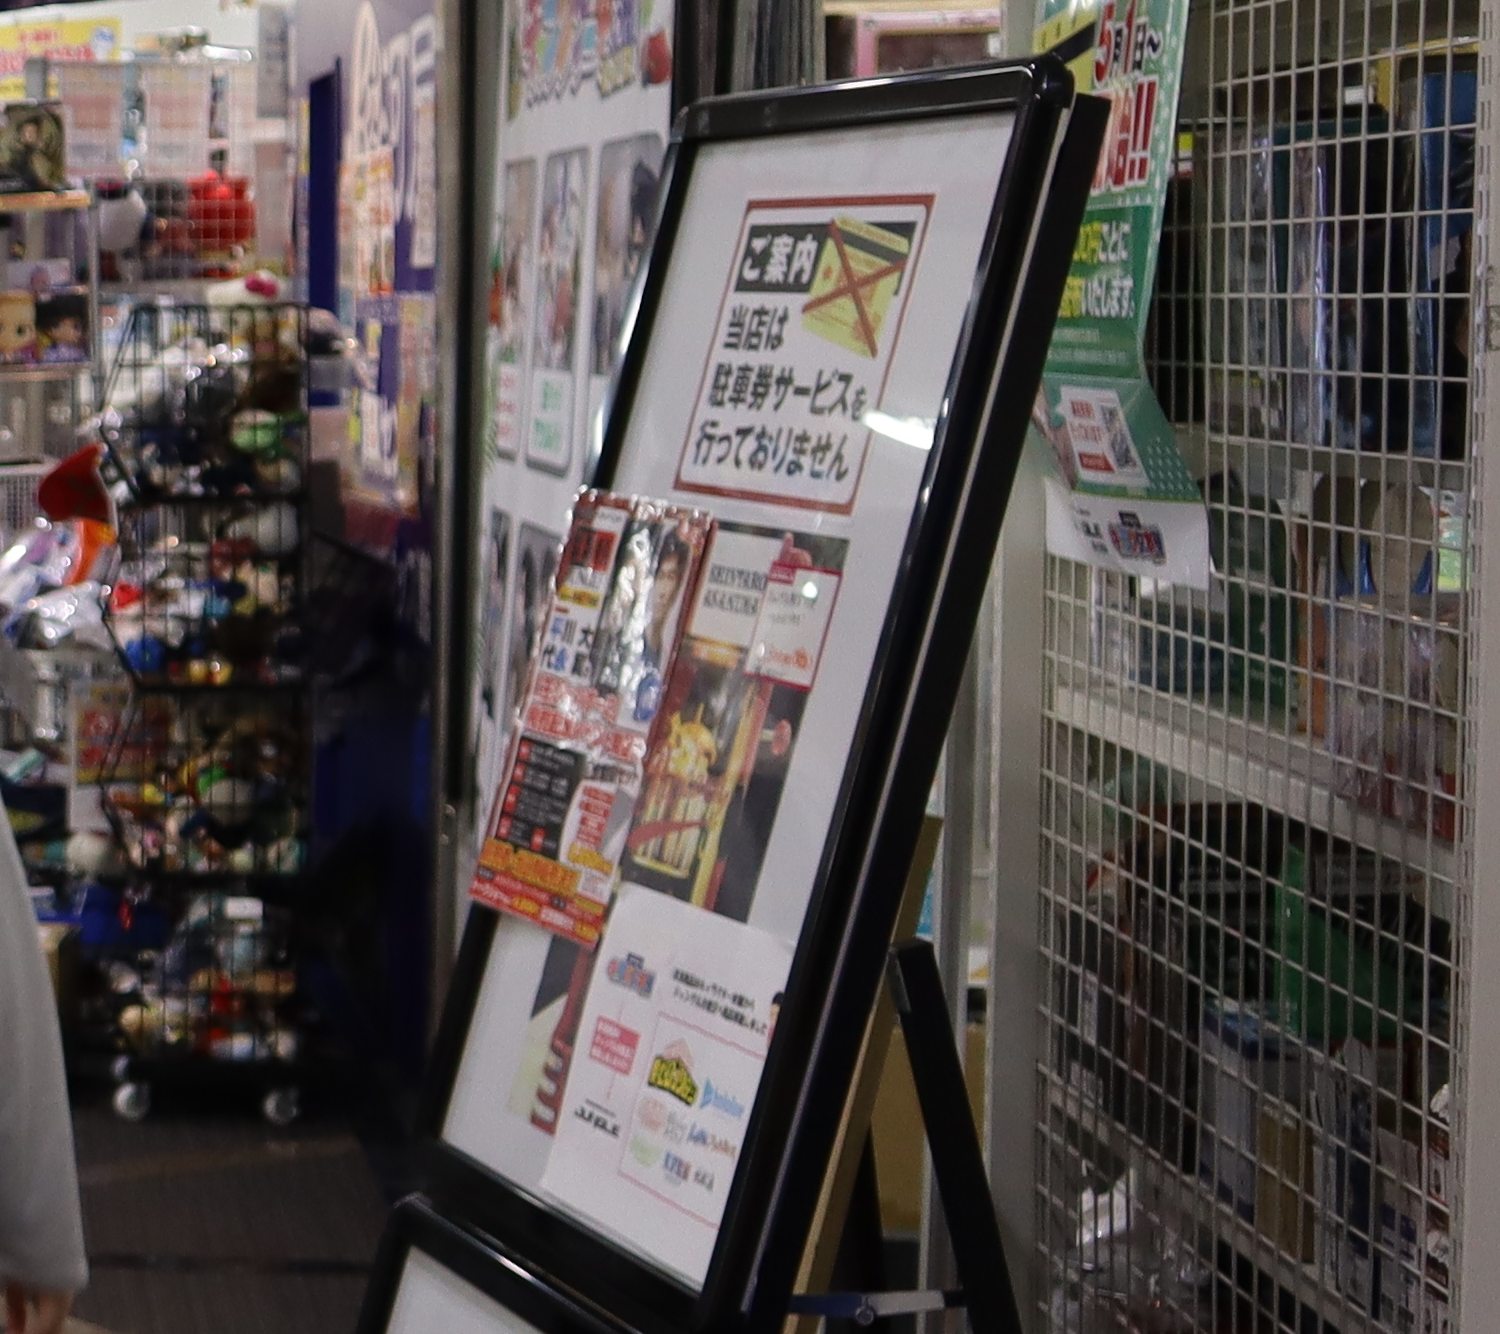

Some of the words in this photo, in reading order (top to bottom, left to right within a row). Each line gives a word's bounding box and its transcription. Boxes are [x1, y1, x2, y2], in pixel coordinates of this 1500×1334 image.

[741, 232, 819, 286] ご案内
[723, 303, 788, 352] 当店は
[708, 365, 868, 420] 駐車券サービスを
[691, 419, 850, 485] 行っておりません
